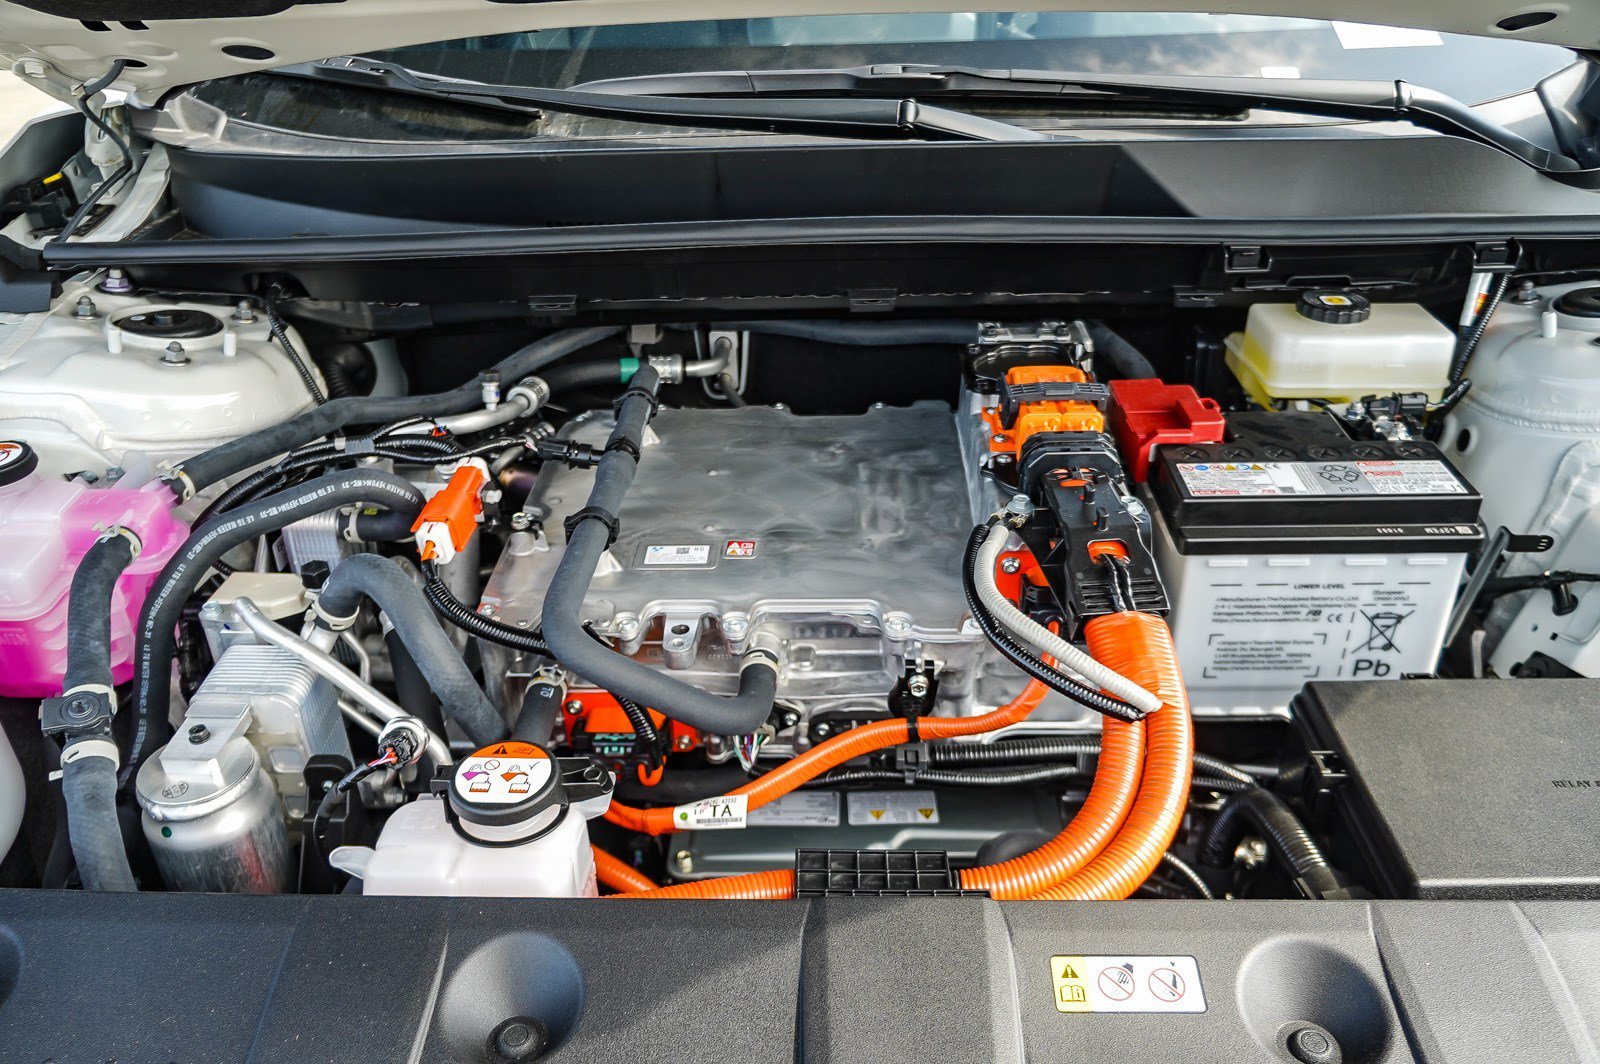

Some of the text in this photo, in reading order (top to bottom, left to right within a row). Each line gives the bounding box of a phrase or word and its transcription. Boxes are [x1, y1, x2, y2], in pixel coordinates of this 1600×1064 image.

[1352, 659, 1391, 677] Pb
[1552, 780, 1591, 788] RELAY
[710, 804, 732, 818] TA
